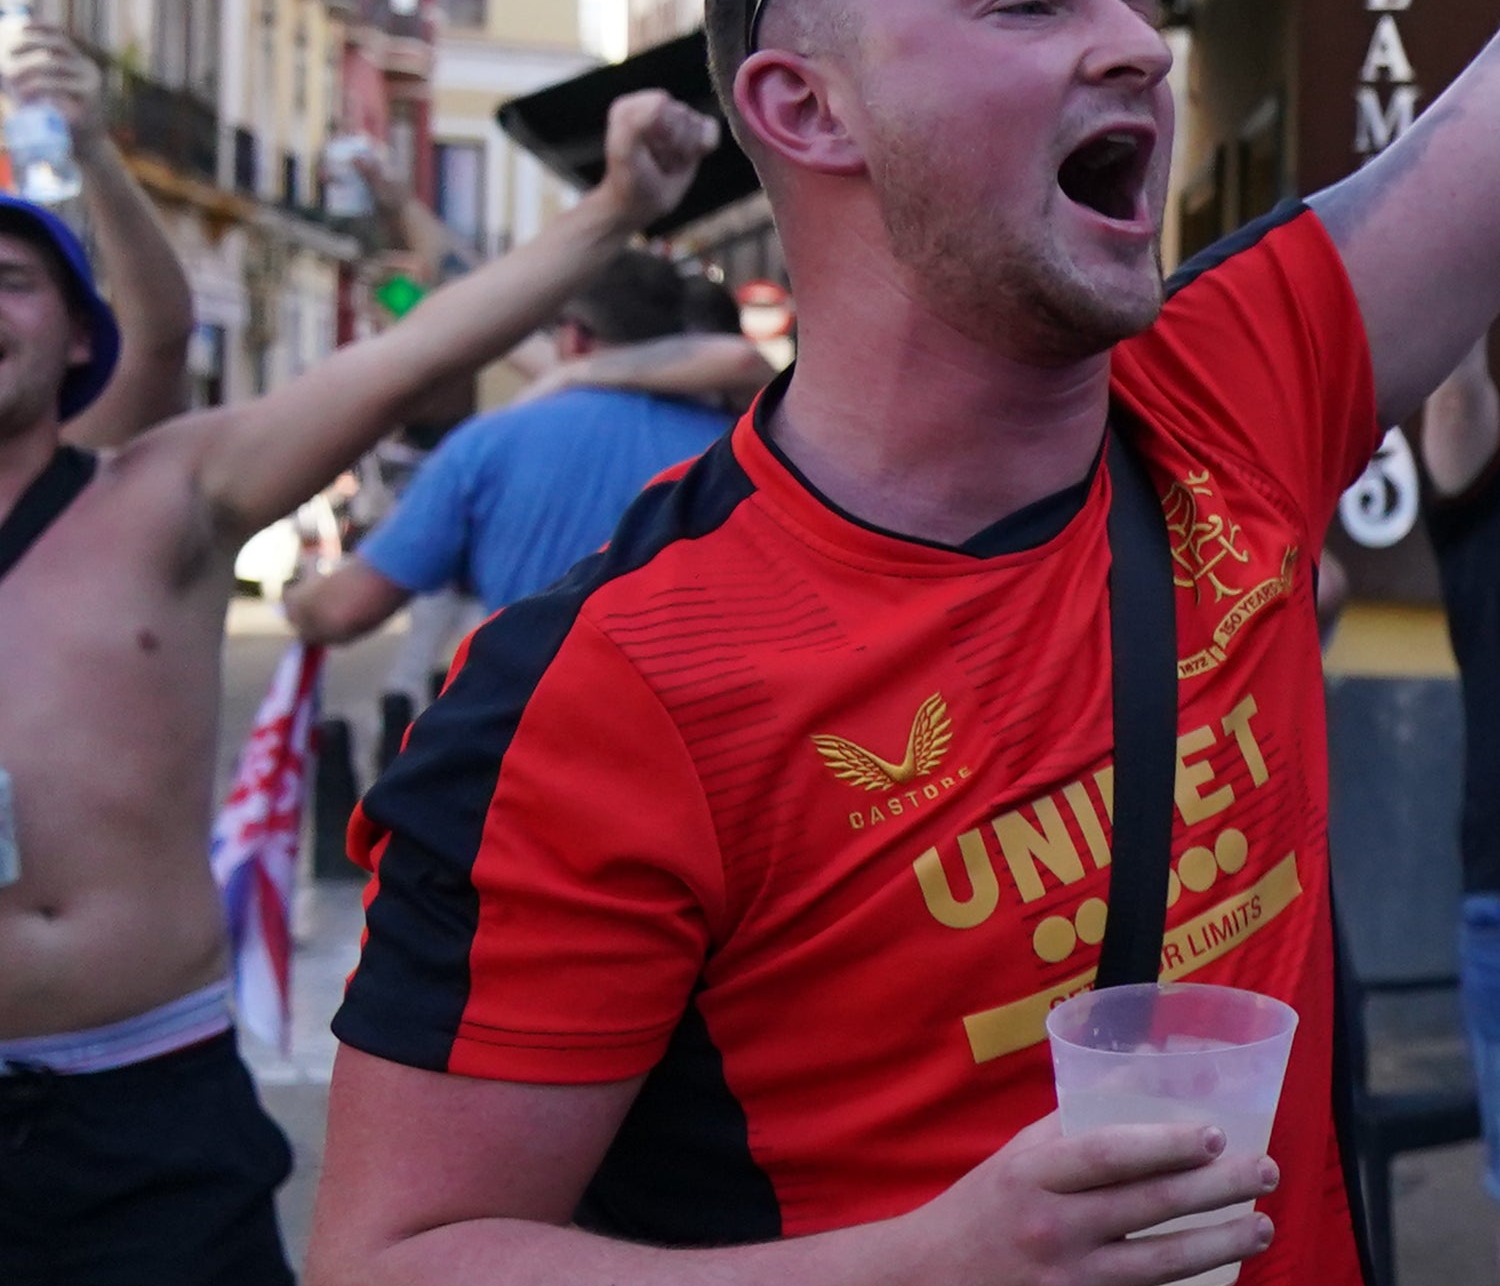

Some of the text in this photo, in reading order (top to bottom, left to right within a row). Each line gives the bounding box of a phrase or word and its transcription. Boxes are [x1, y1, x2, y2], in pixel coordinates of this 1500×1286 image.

[849, 766, 973, 830] CASTORE
[913, 693, 1270, 929] UNIET
[1187, 895, 1262, 958] LIMITS
